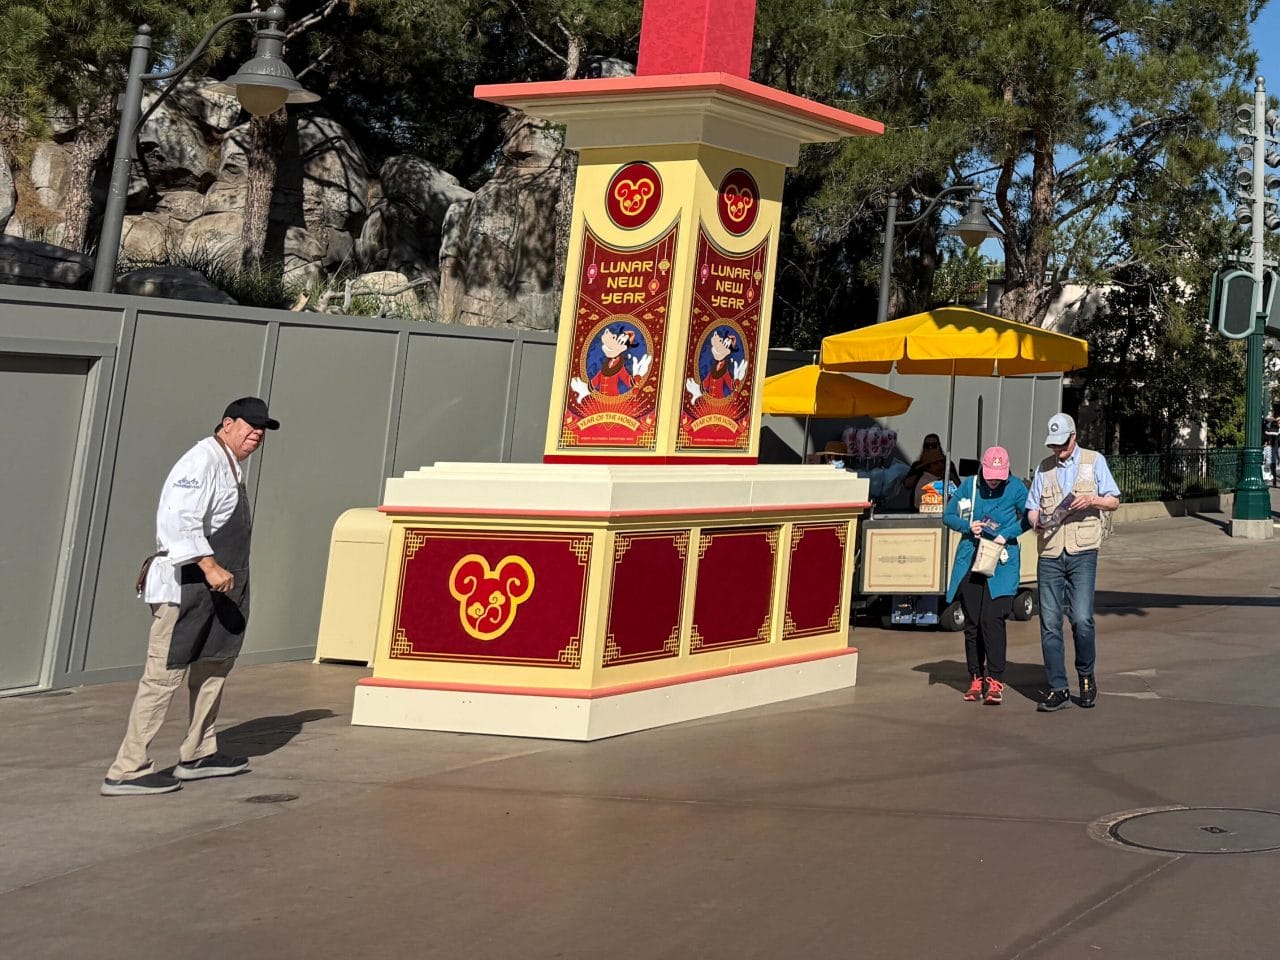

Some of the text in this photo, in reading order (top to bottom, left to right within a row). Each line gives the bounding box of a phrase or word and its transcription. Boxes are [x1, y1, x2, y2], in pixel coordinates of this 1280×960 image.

[600, 260, 654, 274] LUNAR
[710, 263, 751, 281] LUNAR
[606, 276, 644, 289] NEW
[715, 279, 744, 295] NEW
[601, 292, 646, 305] YEAR
[711, 294, 745, 310] YEAR
